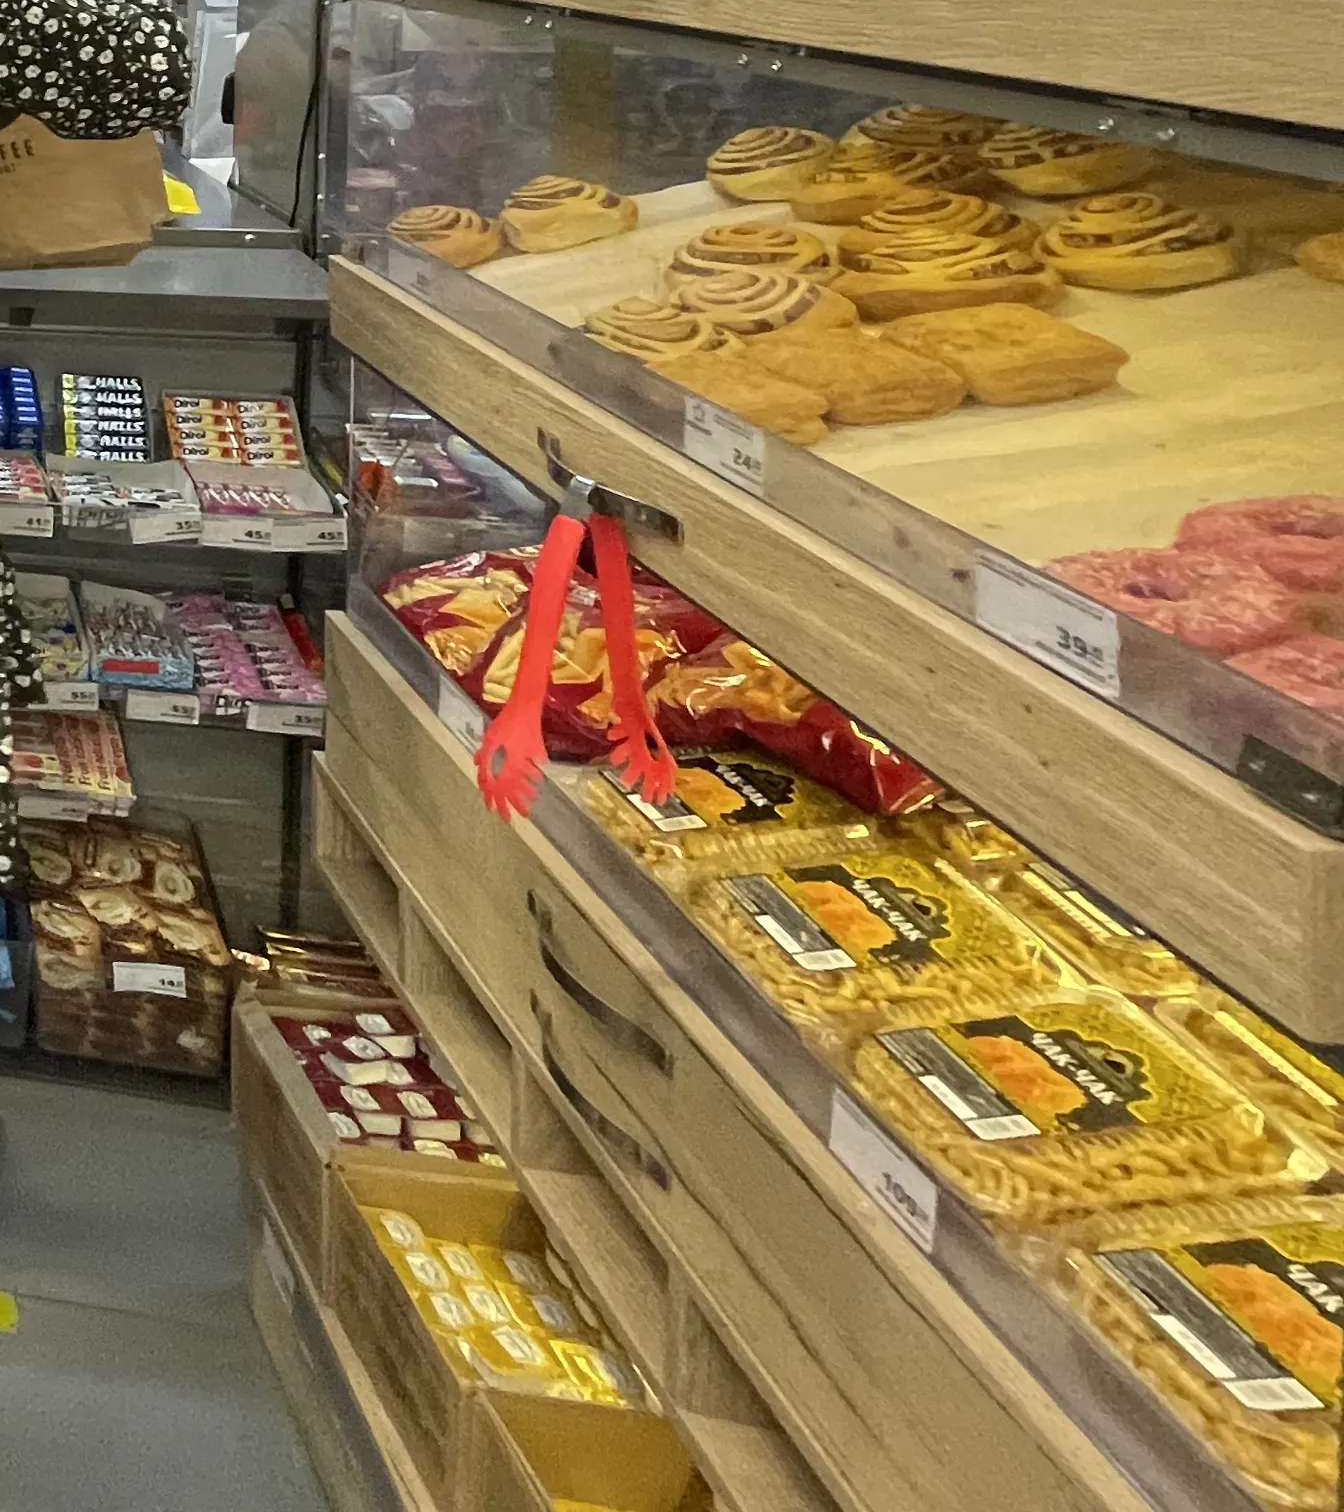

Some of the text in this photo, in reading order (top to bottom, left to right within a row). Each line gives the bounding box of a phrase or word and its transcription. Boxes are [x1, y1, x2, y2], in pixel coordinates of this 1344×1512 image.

[1056, 625, 1088, 658] 39
[851, 878, 929, 943] ЧАК-ЧАК
[1031, 1032, 1124, 1105] ЧАК-ЧАК
[881, 1171, 918, 1217] 109
